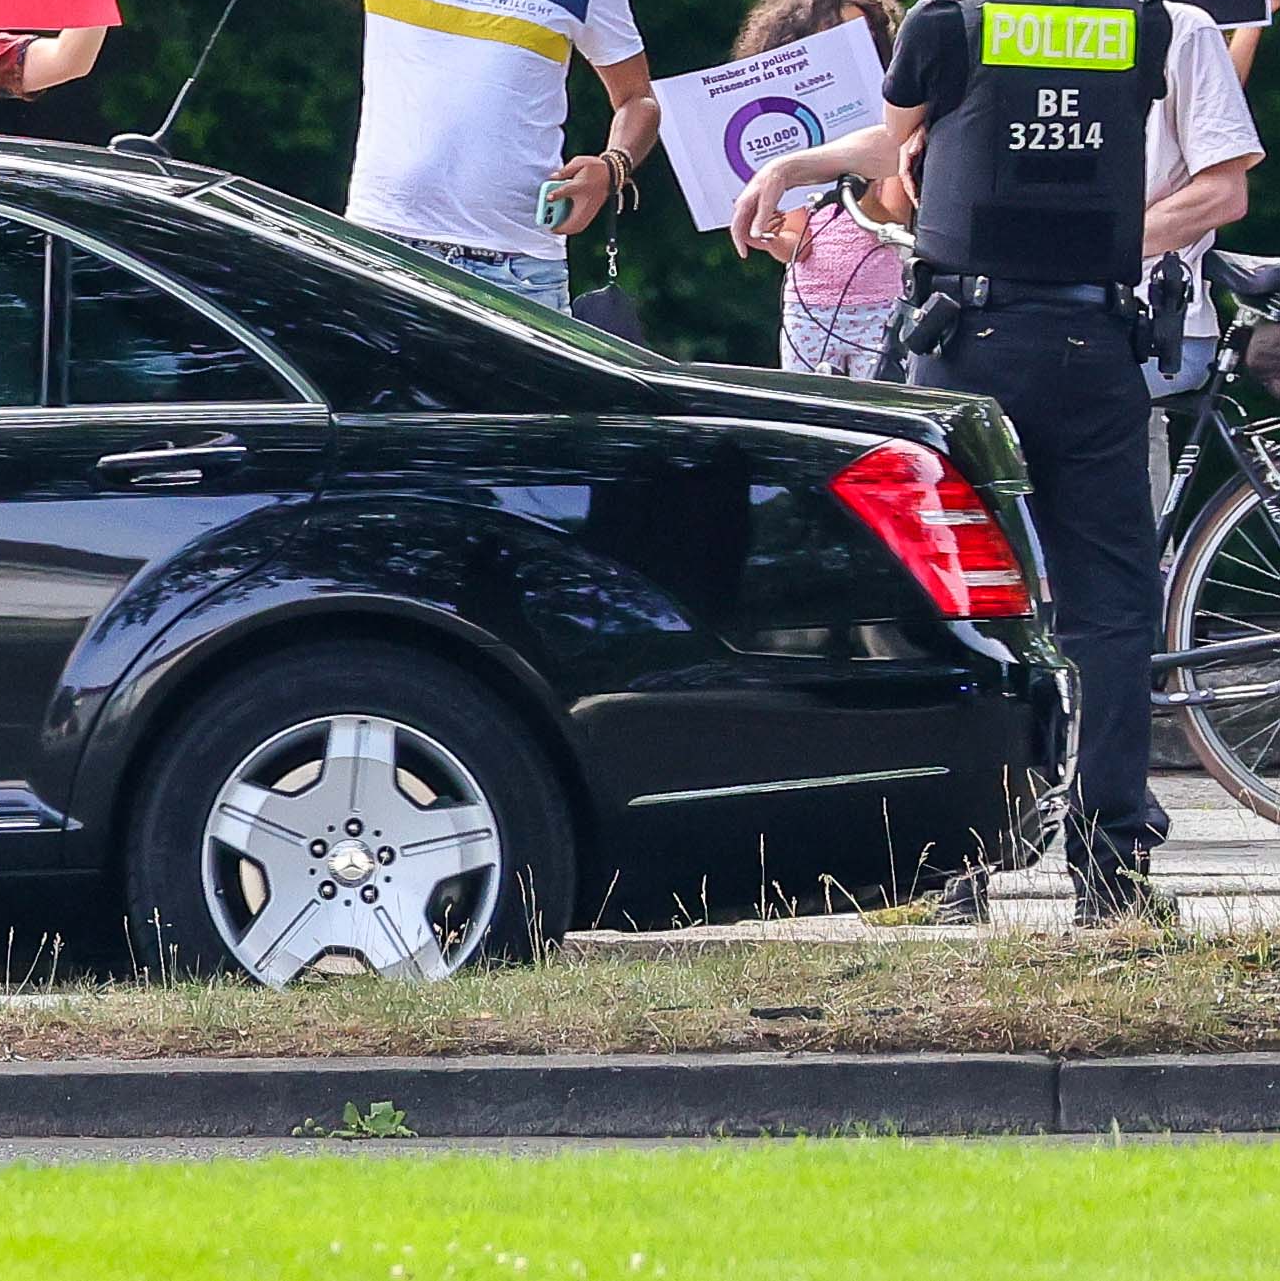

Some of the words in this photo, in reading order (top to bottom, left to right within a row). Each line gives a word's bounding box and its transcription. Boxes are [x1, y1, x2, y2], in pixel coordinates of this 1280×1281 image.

[990, 12, 1128, 61] POLIZEI
[701, 63, 747, 86] Number
[748, 61, 760, 74] of
[761, 45, 810, 70] political
[709, 75, 762, 98] prisoners
[763, 70, 776, 82] in
[776, 58, 810, 78] Egypt
[1037, 88, 1080, 118] BE
[1008, 122, 1104, 151] 32314
